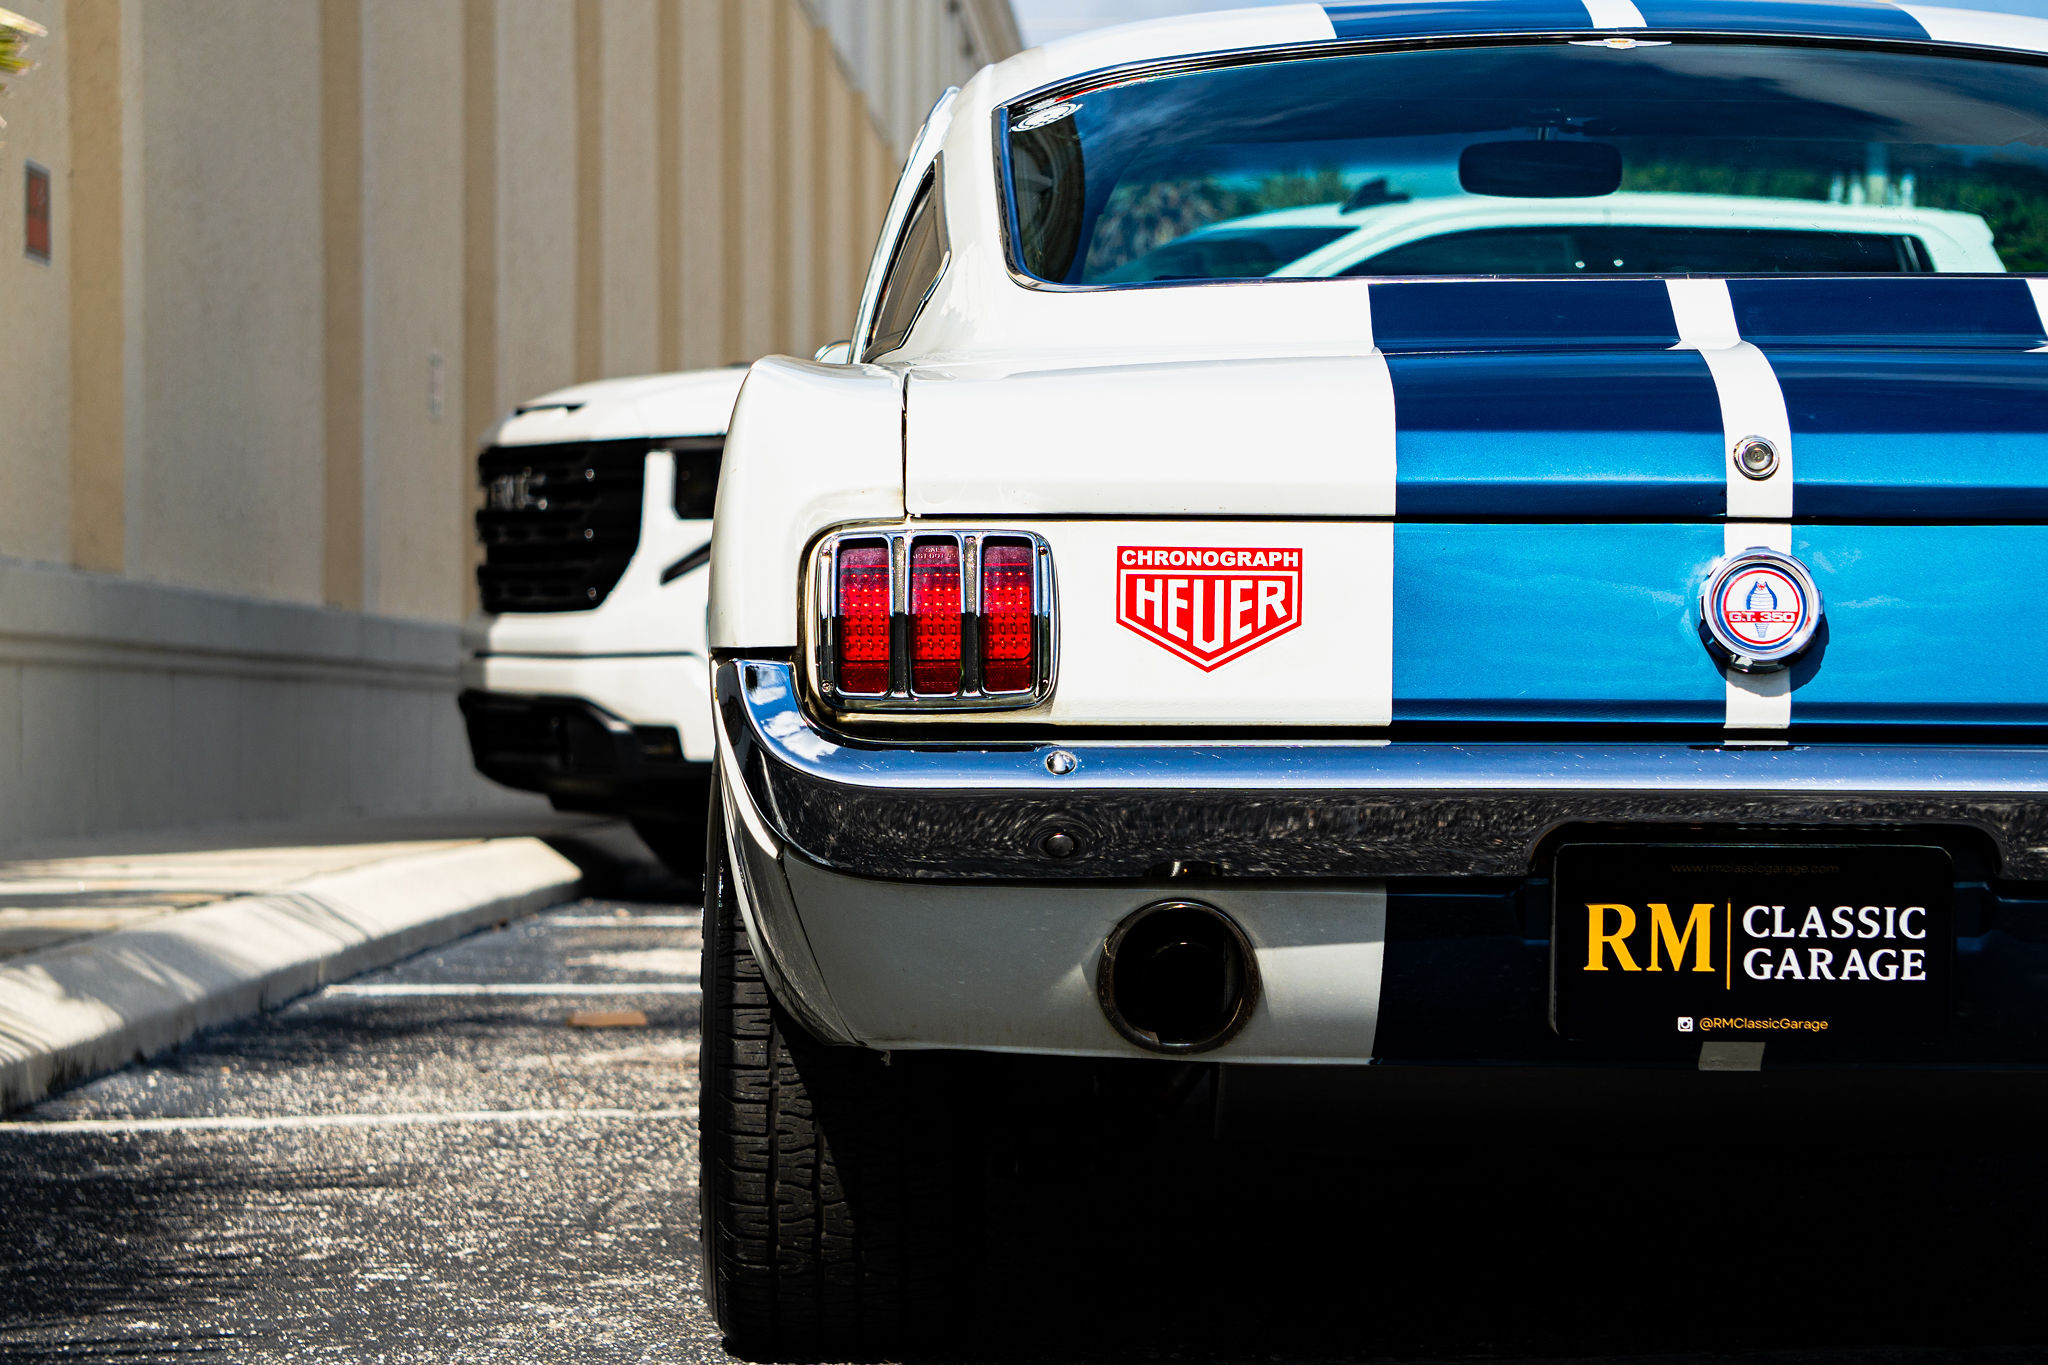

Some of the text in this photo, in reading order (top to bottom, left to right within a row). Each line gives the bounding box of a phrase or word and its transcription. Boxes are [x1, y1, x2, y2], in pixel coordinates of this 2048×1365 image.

[1121, 549, 1299, 567] CHRONOGRAPH
[1136, 578, 1287, 653] HEUER
[1760, 612, 1796, 622] 350
[1671, 862, 1840, 875] www.rmclassicgarage.com
[1743, 905, 1927, 939] CLASSIC
[1583, 903, 1716, 972] RM
[1743, 947, 1927, 982] GARAGE
[1699, 1016, 1829, 1032] @RMClassicGarage
